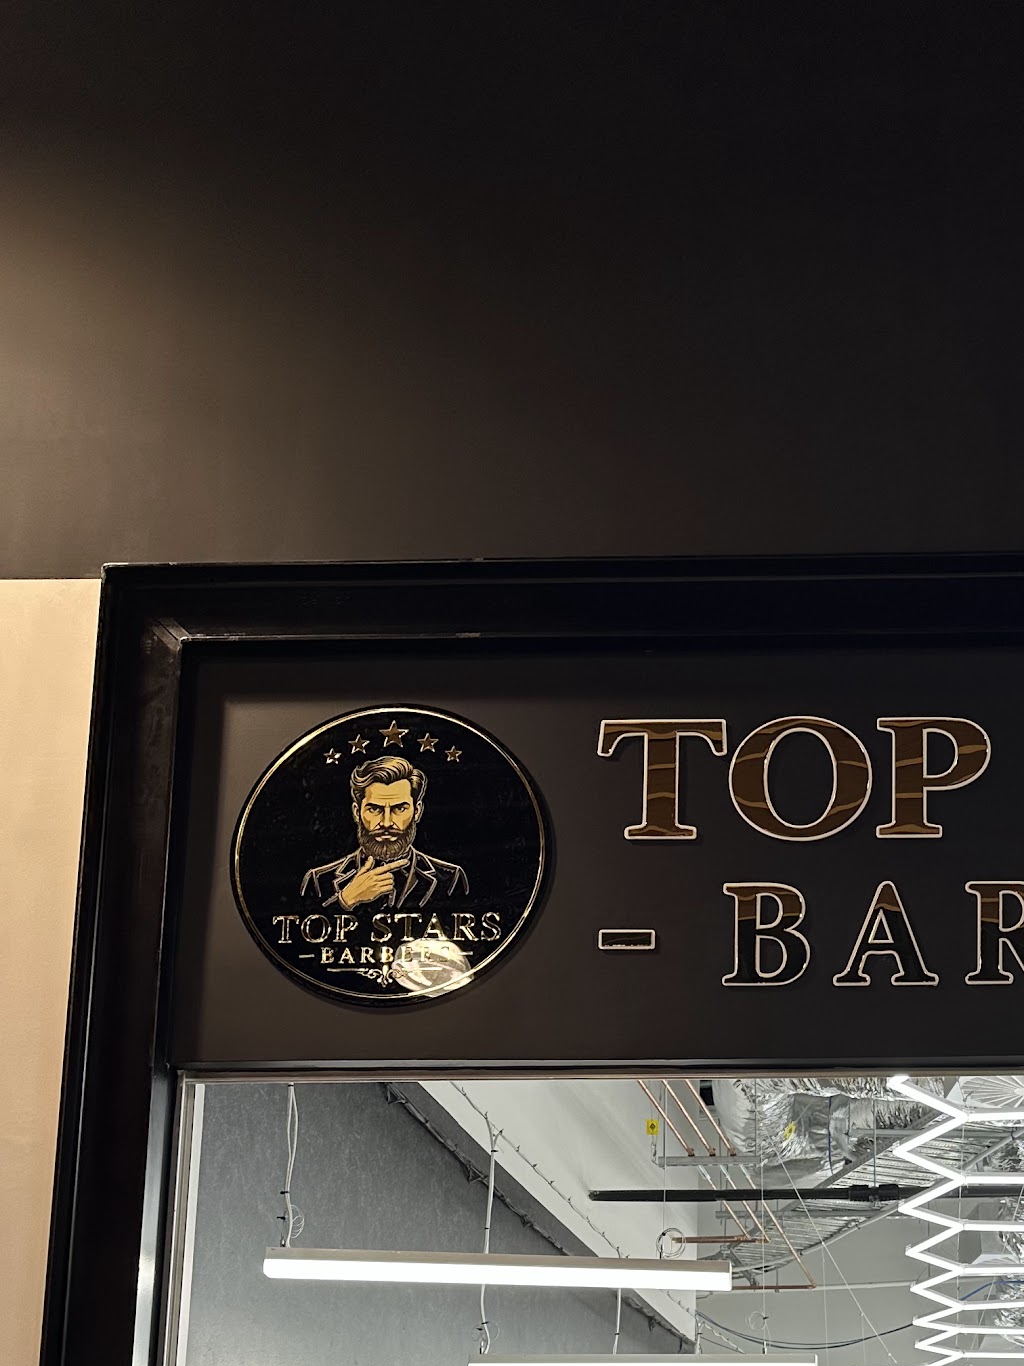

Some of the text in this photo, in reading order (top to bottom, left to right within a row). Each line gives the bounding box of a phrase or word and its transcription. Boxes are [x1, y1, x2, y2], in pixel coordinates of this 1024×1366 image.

[597, 715, 991, 841] TOP
[272, 910, 502, 944] TOP STARS
